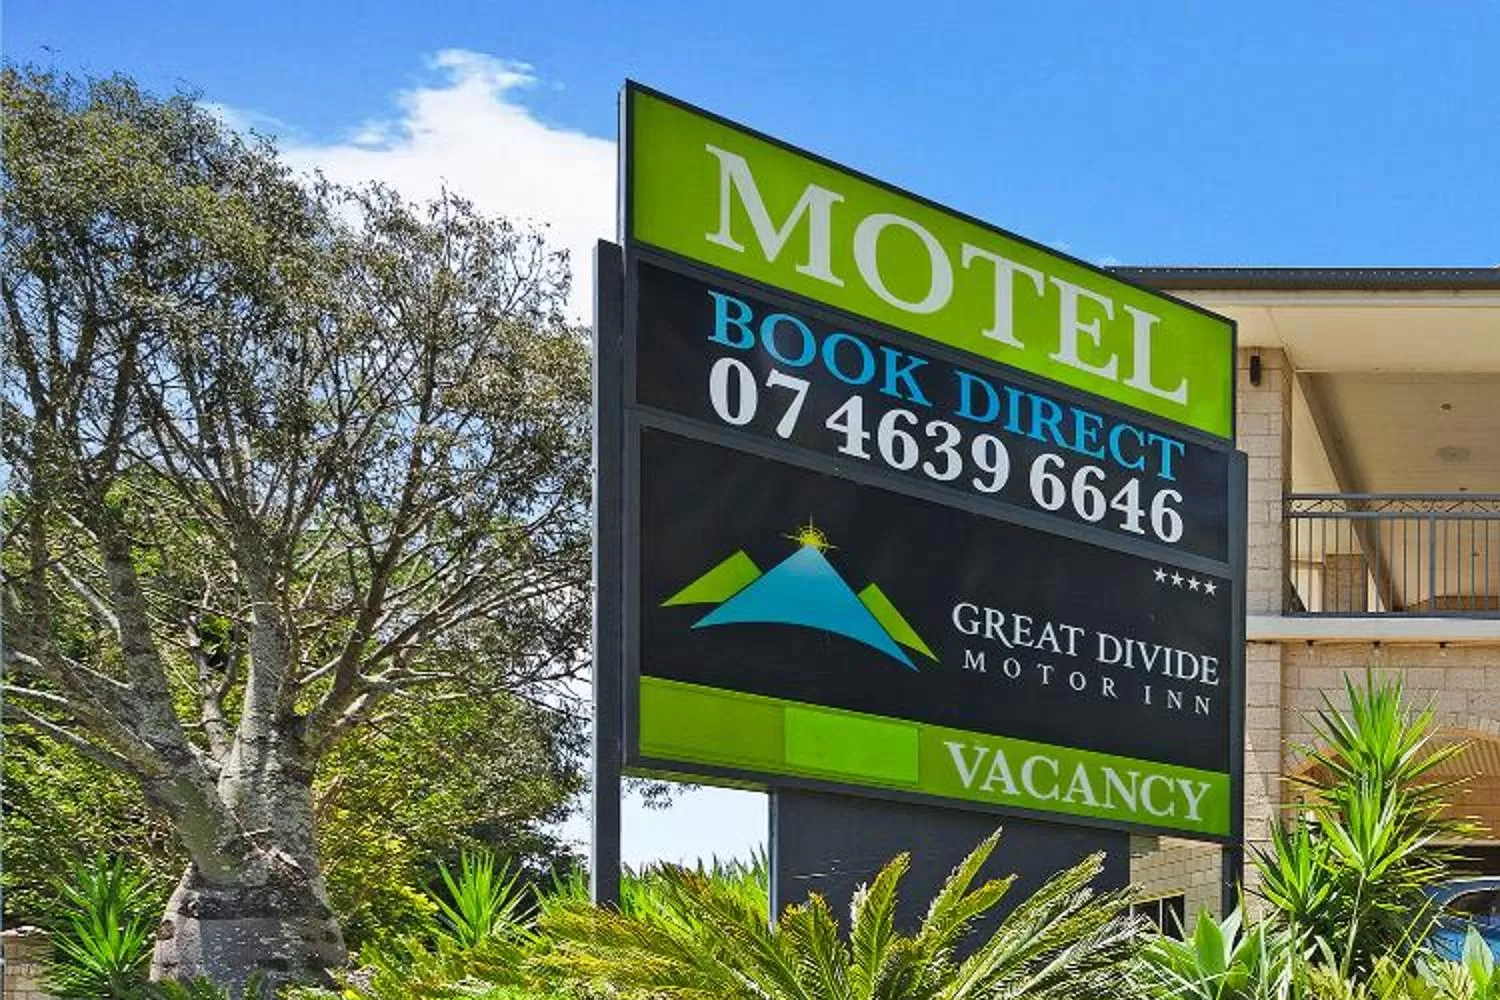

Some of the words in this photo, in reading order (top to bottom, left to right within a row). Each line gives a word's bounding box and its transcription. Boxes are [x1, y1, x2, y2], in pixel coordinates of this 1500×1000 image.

[705, 143, 1189, 406] MOTEL
[707, 290, 932, 408] BOOK
[954, 369, 1185, 481] DIRECT
[708, 356, 810, 439] 07
[825, 395, 1010, 493] 4639
[1029, 452, 1184, 543] 6646
[951, 602, 1085, 657] GREAT
[1096, 633, 1220, 686] DIVIDE
[962, 650, 1117, 698] MOTOR
[1144, 685, 1212, 716] INN
[943, 741, 1212, 822] VACANCY
